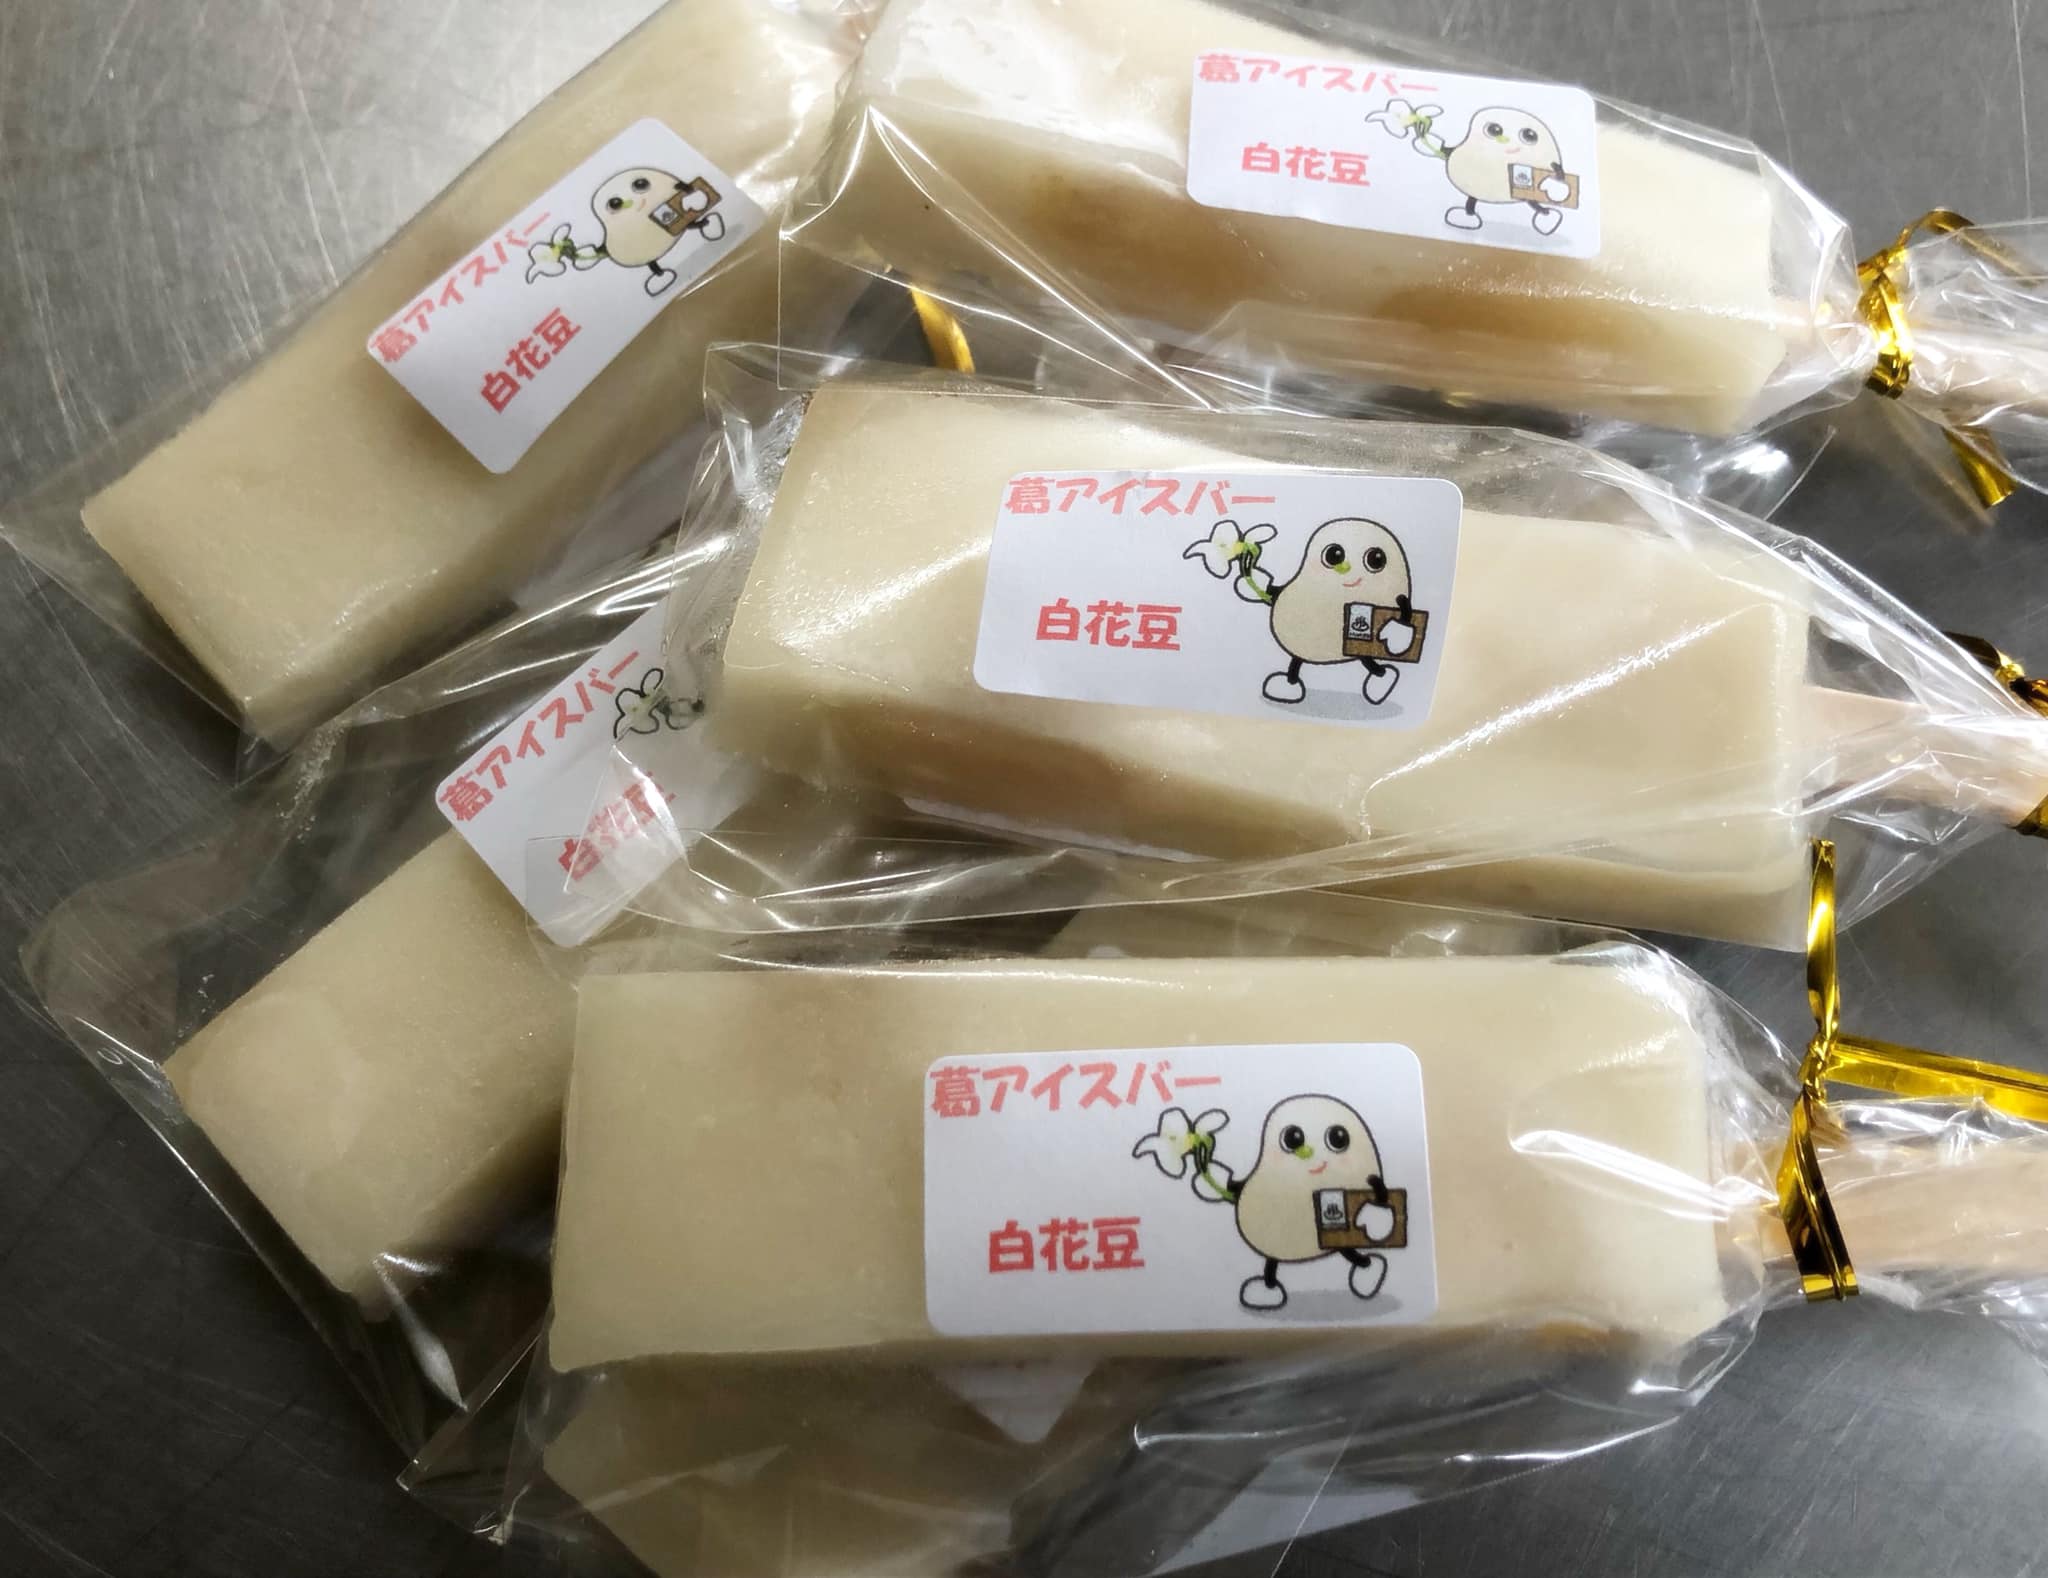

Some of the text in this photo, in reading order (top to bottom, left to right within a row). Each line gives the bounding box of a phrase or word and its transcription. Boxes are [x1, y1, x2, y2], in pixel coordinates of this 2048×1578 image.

[1199, 53, 1439, 94] 葛アイスバー
[1241, 142, 1370, 187] 白花豆
[370, 211, 551, 363] 葛アイスバー
[480, 307, 581, 413] 白花豆
[1005, 477, 1276, 516] 葛アイスバー
[1036, 597, 1183, 651] 白花豆
[440, 651, 639, 821] 葛アイスバー
[929, 1061, 1221, 1118] 葛アイスバー
[988, 1216, 1145, 1273] 白花豆
